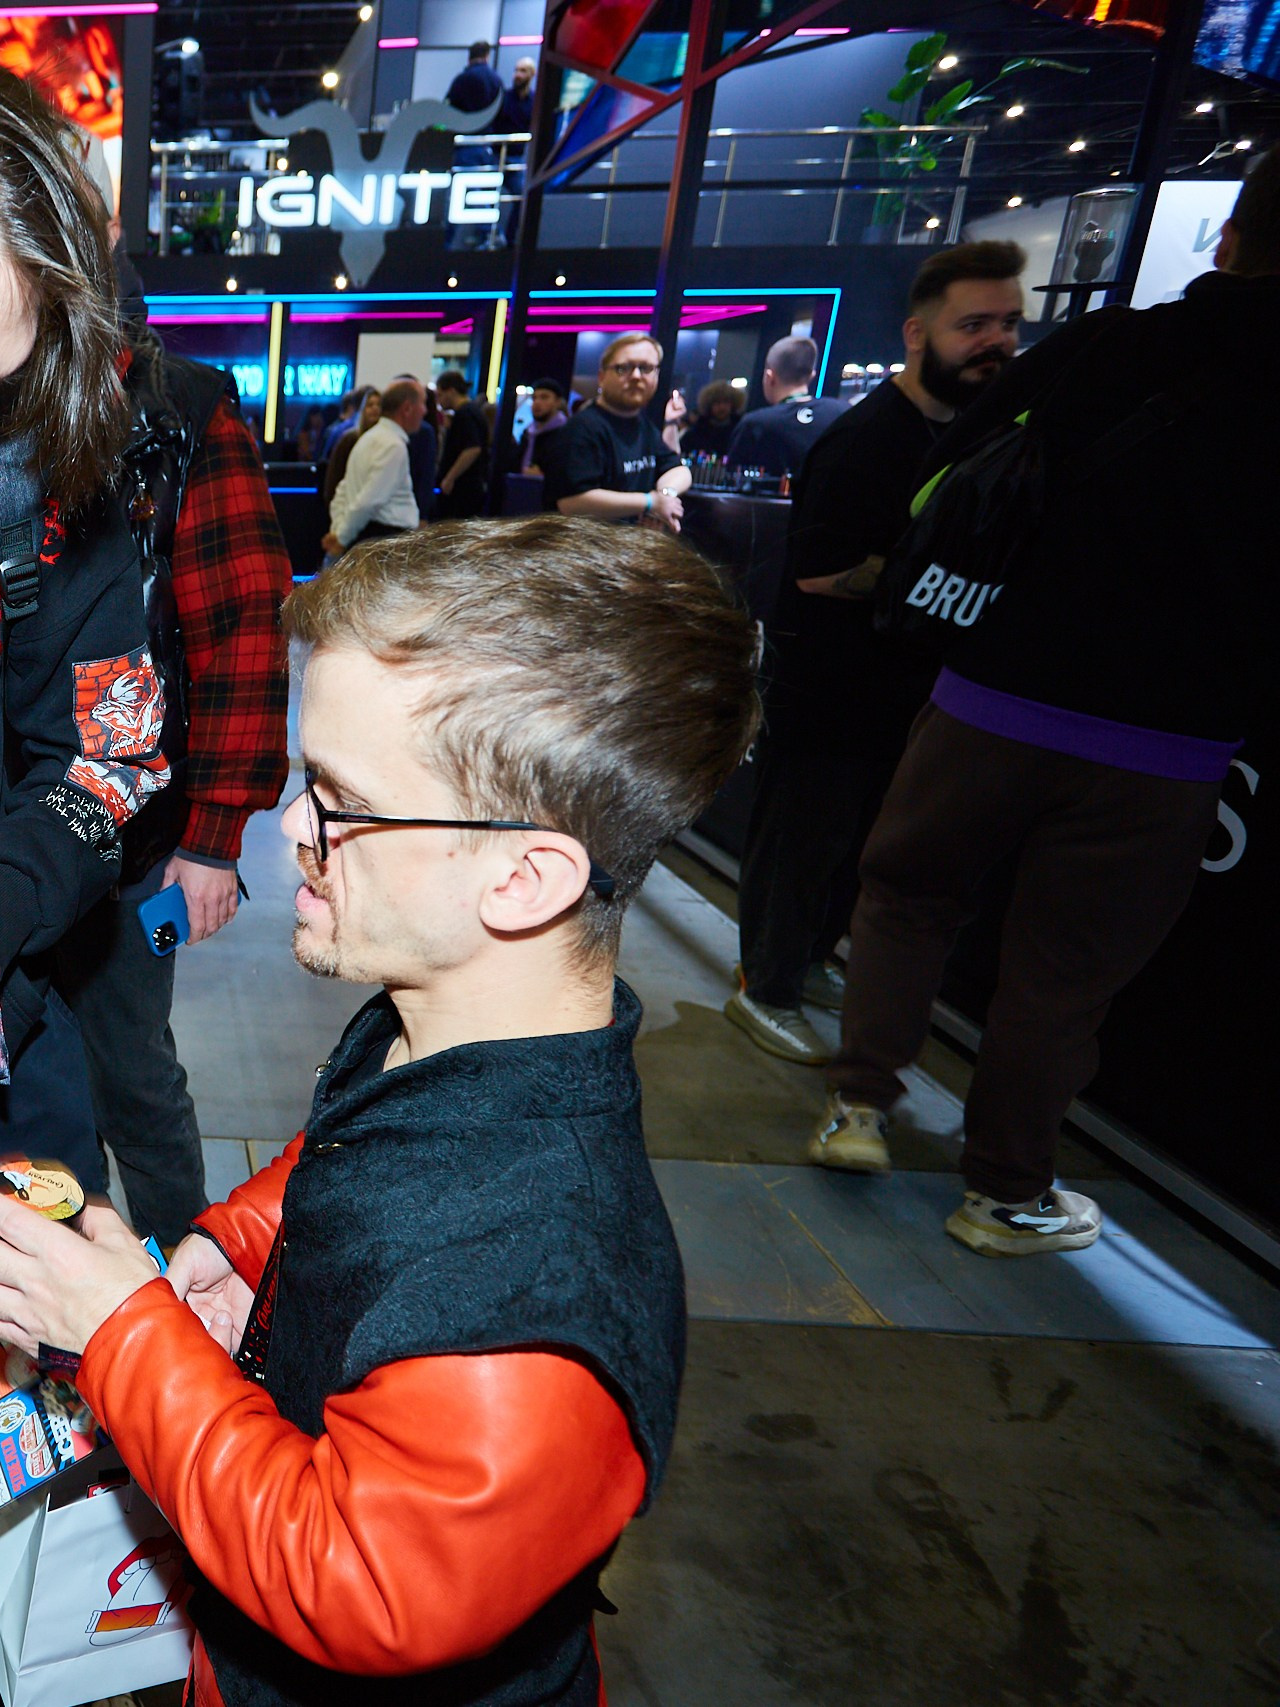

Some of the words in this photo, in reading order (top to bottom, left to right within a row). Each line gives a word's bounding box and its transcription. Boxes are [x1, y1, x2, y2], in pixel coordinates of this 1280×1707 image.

[238, 172, 504, 227] IGNITE
[297, 364, 348, 396] WAY
[0, 1436, 27, 1493] SIBERIA
[47, 1414, 76, 1463] ICEB
